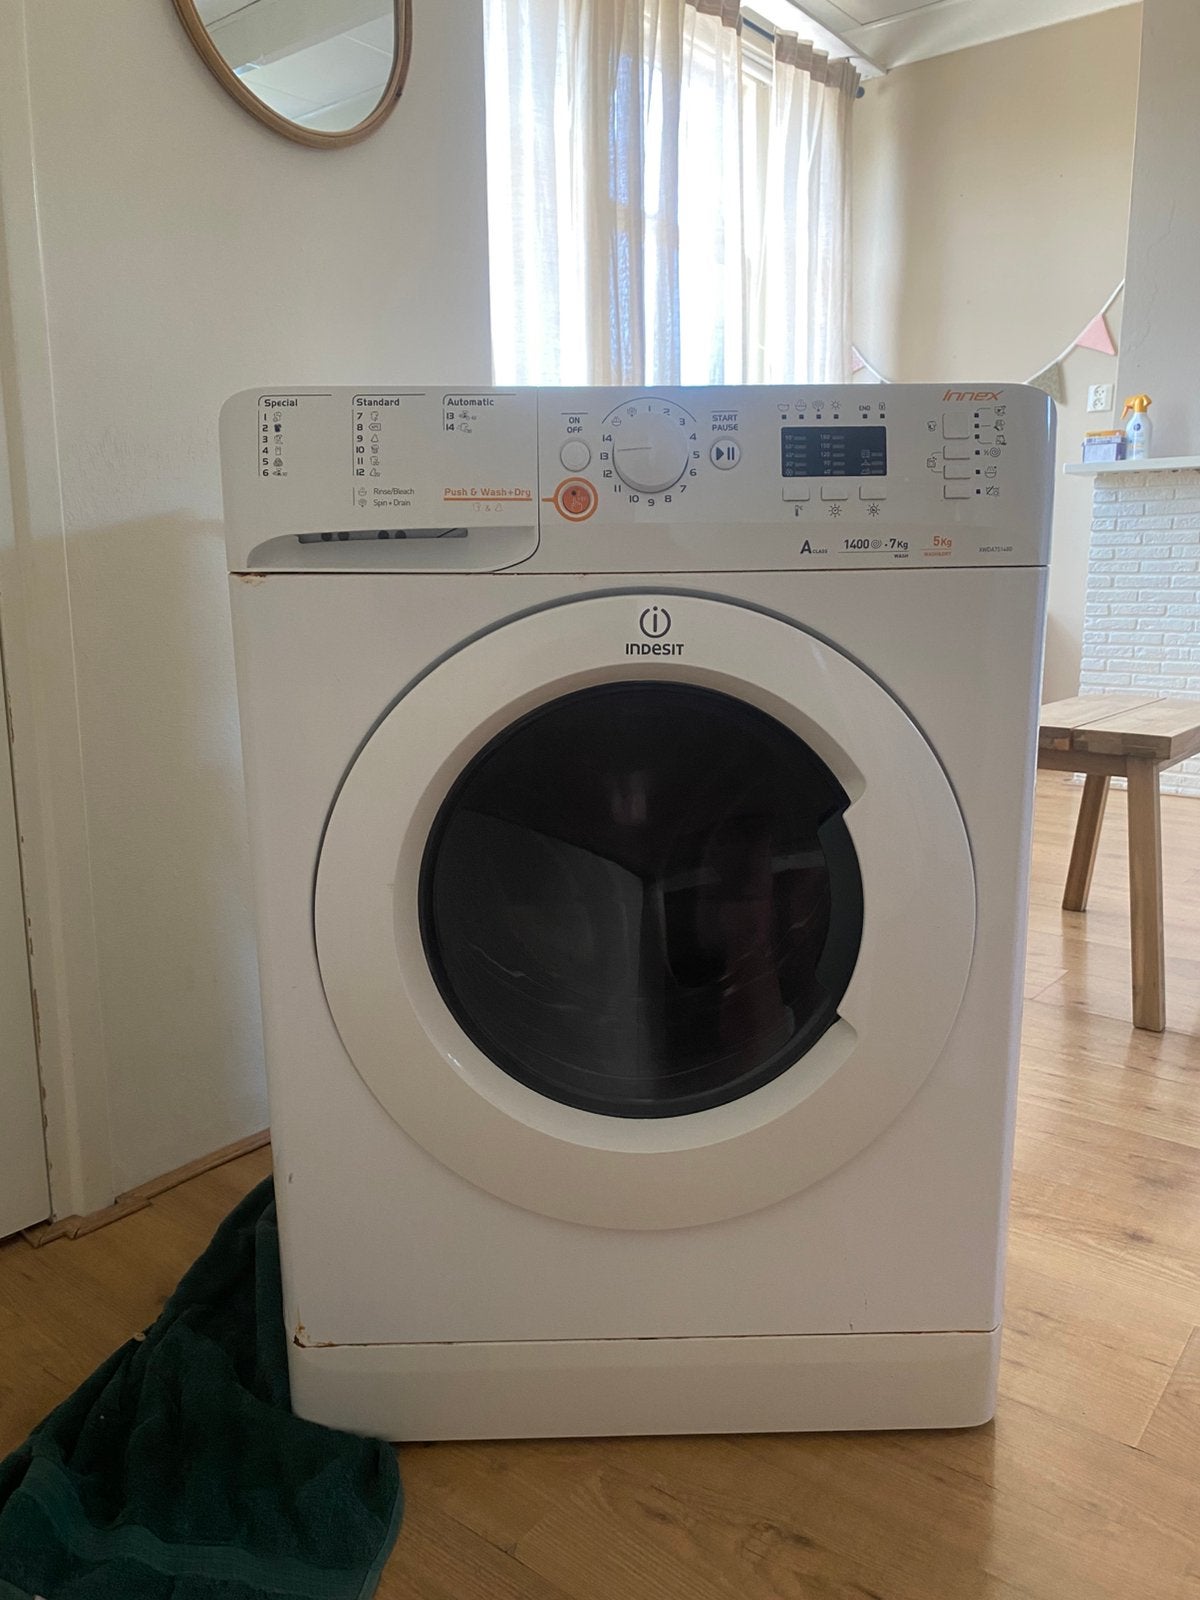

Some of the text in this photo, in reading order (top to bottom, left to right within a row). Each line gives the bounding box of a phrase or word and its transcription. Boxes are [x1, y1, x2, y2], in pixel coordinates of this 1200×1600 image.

[942, 389, 1004, 401] Innex
[264, 398, 298, 408] Special
[356, 398, 400, 407] Standard
[447, 398, 494, 406] Automatic
[356, 412, 363, 420] 7
[446, 412, 455, 420] 13
[568, 416, 580, 424] ON
[712, 414, 737, 422] START
[679, 418, 686, 426] 3
[262, 424, 268, 432] 2
[356, 423, 363, 431] 8
[446, 423, 455, 431] 14
[567, 426, 583, 434] OFF
[712, 424, 739, 432] PAUSE
[262, 435, 268, 443] 3
[356, 434, 363, 442] 9
[602, 434, 613, 442] 14
[689, 433, 697, 441] 4
[600, 452, 609, 460] 13
[692, 451, 700, 459] 5
[357, 457, 364, 465] 11
[603, 469, 613, 478] 12
[689, 468, 697, 476] 6
[373, 487, 415, 495] Rinse/Bleach
[444, 488, 531, 498] Push & Wash+Dry
[614, 485, 622, 493] 11
[680, 485, 687, 493] 7
[629, 494, 640, 503] 10
[664, 495, 672, 503] 8
[373, 499, 388, 508] Spin
[647, 499, 655, 507] 9
[844, 539, 870, 549] 1400
[933, 535, 952, 548] 5Kg
[800, 540, 812, 554] A
